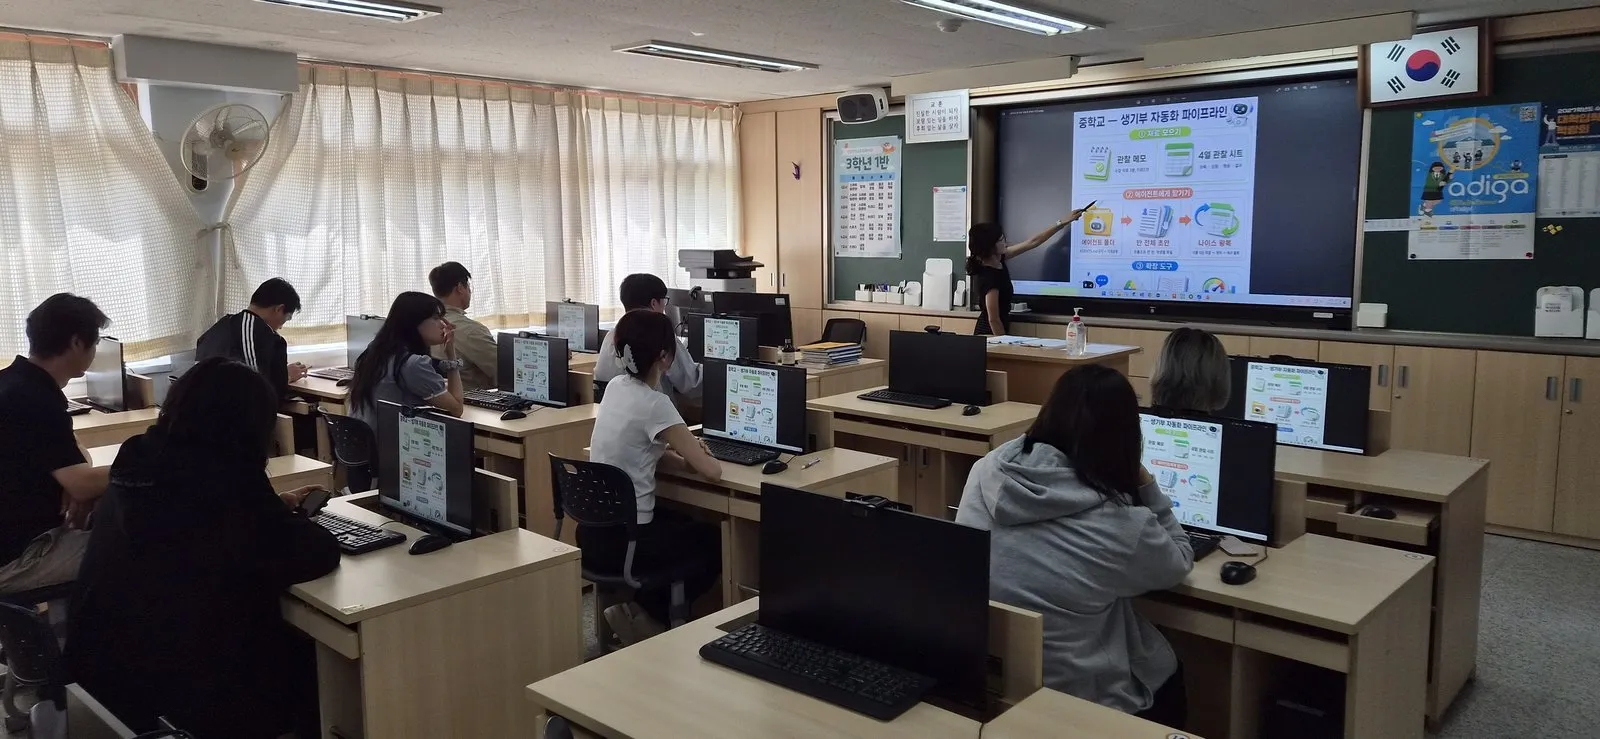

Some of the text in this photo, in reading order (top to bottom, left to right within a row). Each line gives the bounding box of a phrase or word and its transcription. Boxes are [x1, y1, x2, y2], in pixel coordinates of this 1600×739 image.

[1079, 116, 1106, 129] 중학교
[1120, 113, 1147, 126] 생기부
[1150, 109, 1178, 123] 자동화
[1182, 105, 1227, 120] 파이프라인
[1162, 127, 1181, 136] 모으기
[1117, 154, 1147, 164] 관찰 메모
[1213, 150, 1228, 159] 관찰
[1229, 149, 1243, 158] 시트
[846, 155, 890, 171] 3학년 1반
[1135, 189, 1171, 198] 에이전트에게
[1448, 174, 1528, 204] adiga
[1144, 239, 1156, 247] 전체
[1198, 239, 1217, 247] 나이스
[1160, 262, 1173, 270] 도구
[1183, 422, 1208, 432] 파이프라인
